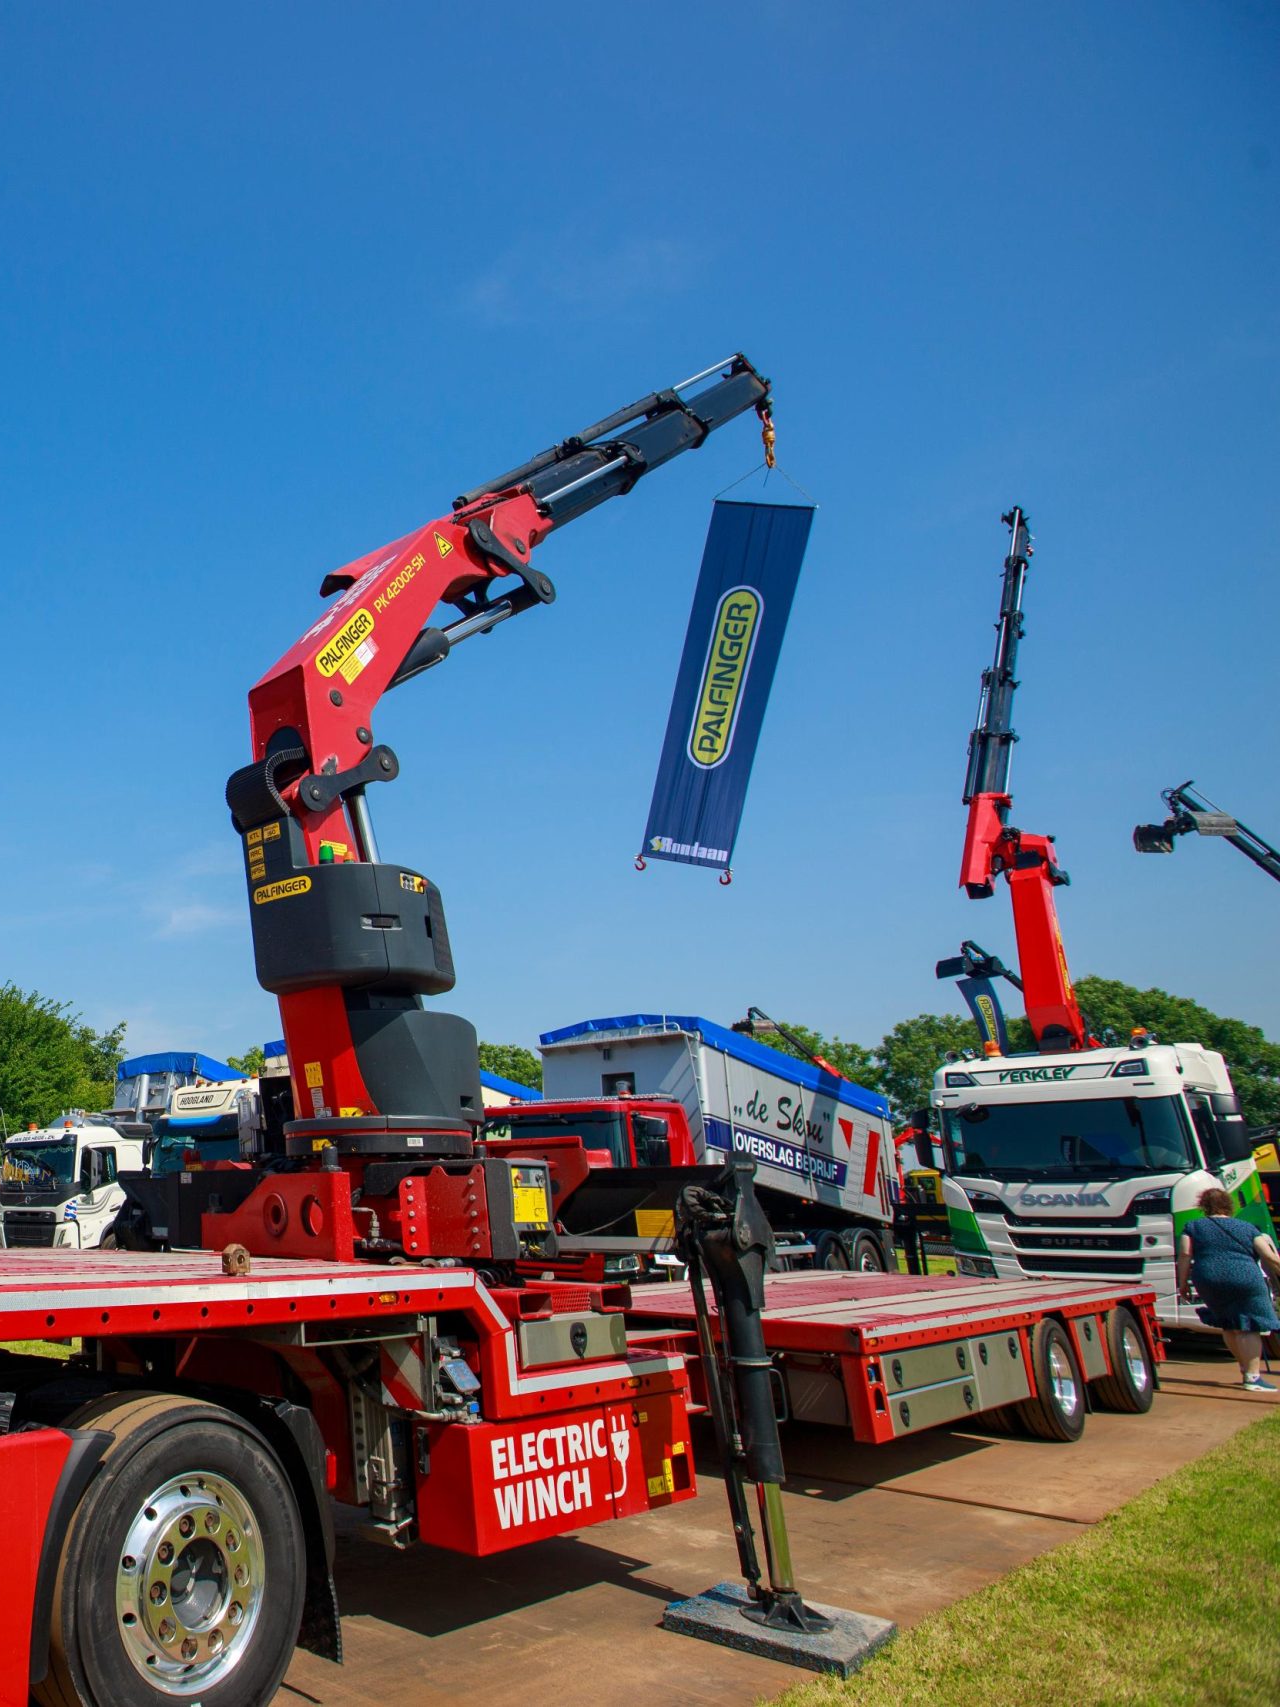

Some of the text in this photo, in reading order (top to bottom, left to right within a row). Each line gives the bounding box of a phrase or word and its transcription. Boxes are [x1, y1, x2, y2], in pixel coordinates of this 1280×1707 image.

[373, 593, 390, 613] PK
[319, 613, 372, 673] PALFINGER
[697, 602, 752, 754] PALFINGER
[659, 836, 728, 862] Rondaan
[256, 879, 307, 901] PALFINGER
[999, 1066, 1077, 1083] VERKLEY
[735, 1131, 838, 1180] OVERSLAG BEDRIJF
[1020, 1193, 1111, 1207] SCANIA
[1040, 1237, 1110, 1246] SUPER
[490, 1418, 607, 1480] ELECTRIC
[493, 1467, 592, 1529] WINCH
